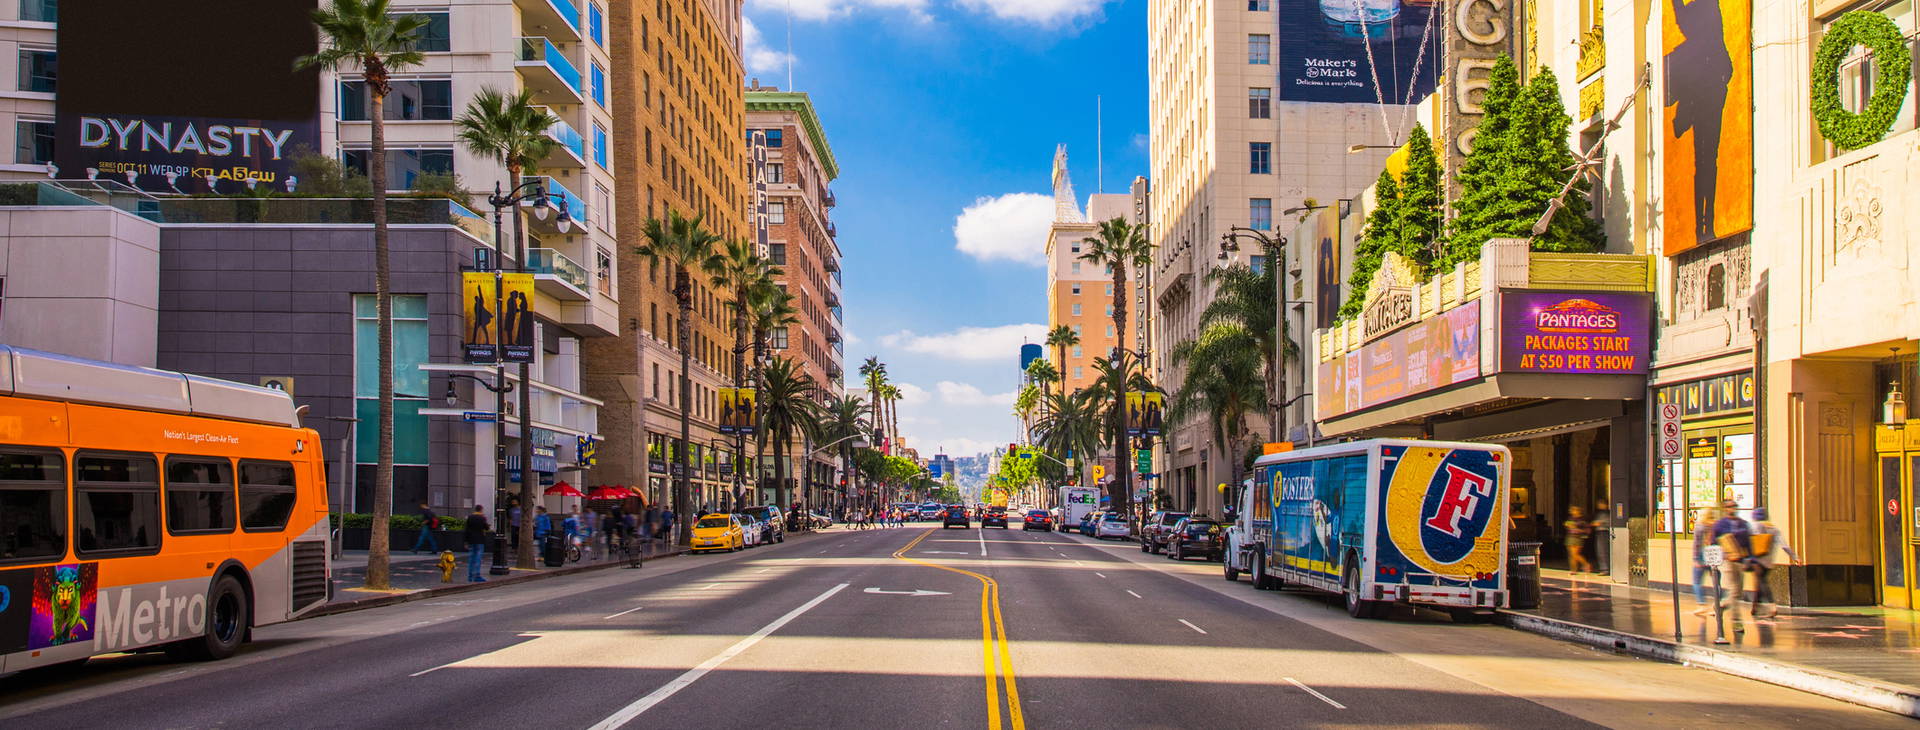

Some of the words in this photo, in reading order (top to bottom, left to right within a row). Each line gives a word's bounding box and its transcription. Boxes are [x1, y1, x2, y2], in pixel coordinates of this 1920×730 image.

[1304, 58, 1357, 67] Maker's
[1320, 69, 1357, 77] Mark
[80, 116, 293, 160] DYNASTY
[117, 163, 136, 173] OCT
[138, 164, 147, 174] 11
[149, 164, 173, 176] WED
[175, 166, 188, 177] 9P
[755, 145, 767, 230] TAFT
[1539, 312, 1617, 328] PANTAGES
[1525, 335, 1589, 351] PACKAGES
[1593, 336, 1631, 351] START
[1520, 354, 1536, 368] AT
[1539, 353, 1564, 370] $50
[1568, 355, 1591, 369] PER
[1595, 355, 1635, 370] SHOW
[164, 429, 185, 439] Nation's
[187, 431, 204, 443] Largest
[228, 435, 239, 444] Fleet
[1069, 493, 1096, 504] FedEx
[1426, 463, 1493, 538] F
[94, 585, 206, 651] Metro
